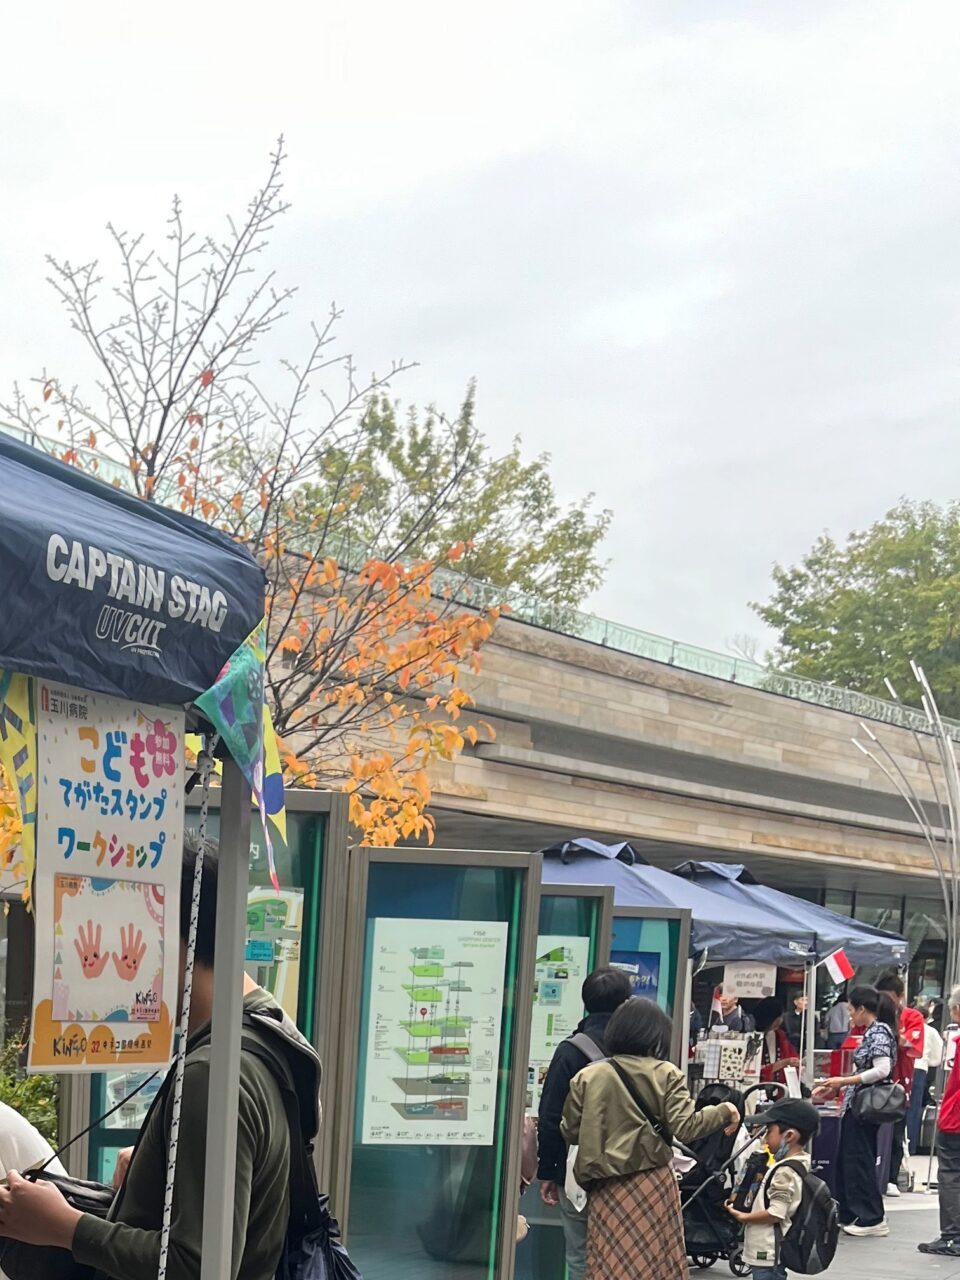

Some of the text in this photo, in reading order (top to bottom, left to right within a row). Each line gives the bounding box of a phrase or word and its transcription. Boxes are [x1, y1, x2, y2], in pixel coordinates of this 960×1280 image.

[46, 533, 228, 633] CAPTAIN STAG
[50, 698, 89, 721] 玉川病院
[78, 726, 150, 789] こども
[58, 777, 168, 821] てがたスタンプ
[57, 827, 166, 869] ワークショップ
